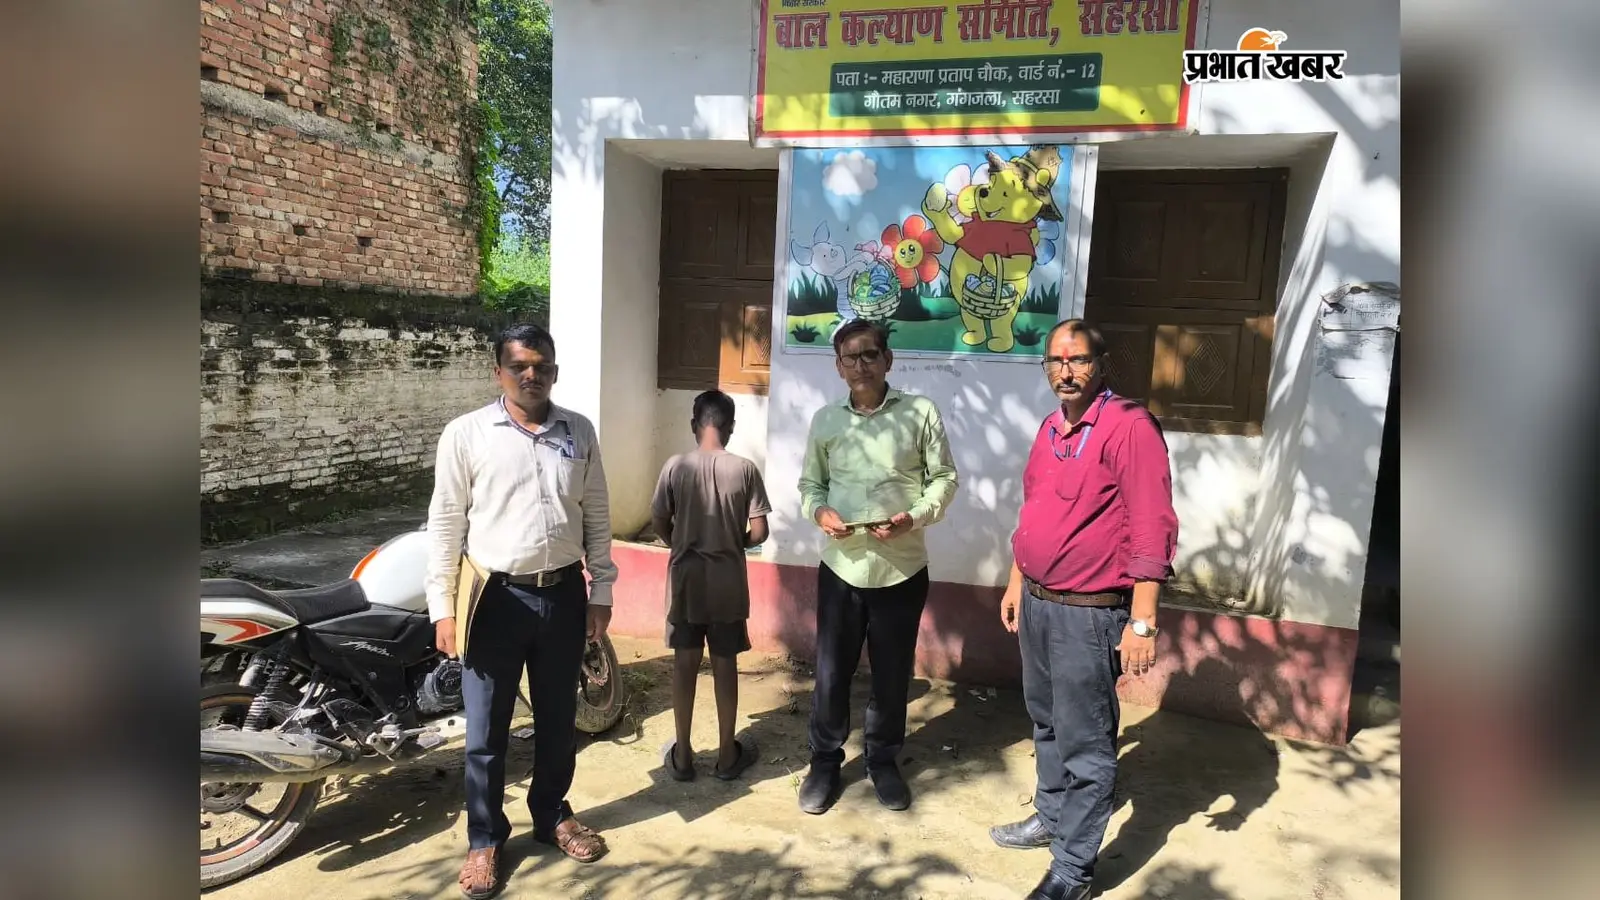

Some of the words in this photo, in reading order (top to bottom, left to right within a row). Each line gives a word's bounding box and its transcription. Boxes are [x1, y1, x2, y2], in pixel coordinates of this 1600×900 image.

[774, 12, 831, 48] बाल
[840, 7, 948, 46] कल्याण
[1078, 0, 1181, 35] सहरसा
[835, 71, 860, 87] पता
[881, 69, 934, 86] महाराणा
[938, 67, 973, 86] प्रताप
[977, 62, 1013, 83] चौक,
[1018, 60, 1045, 81] वार्ड
[1081, 62, 1096, 79] 12
[863, 90, 902, 110] गौतम
[906, 92, 942, 109] नगर,
[1012, 88, 1061, 106] सहरसा
